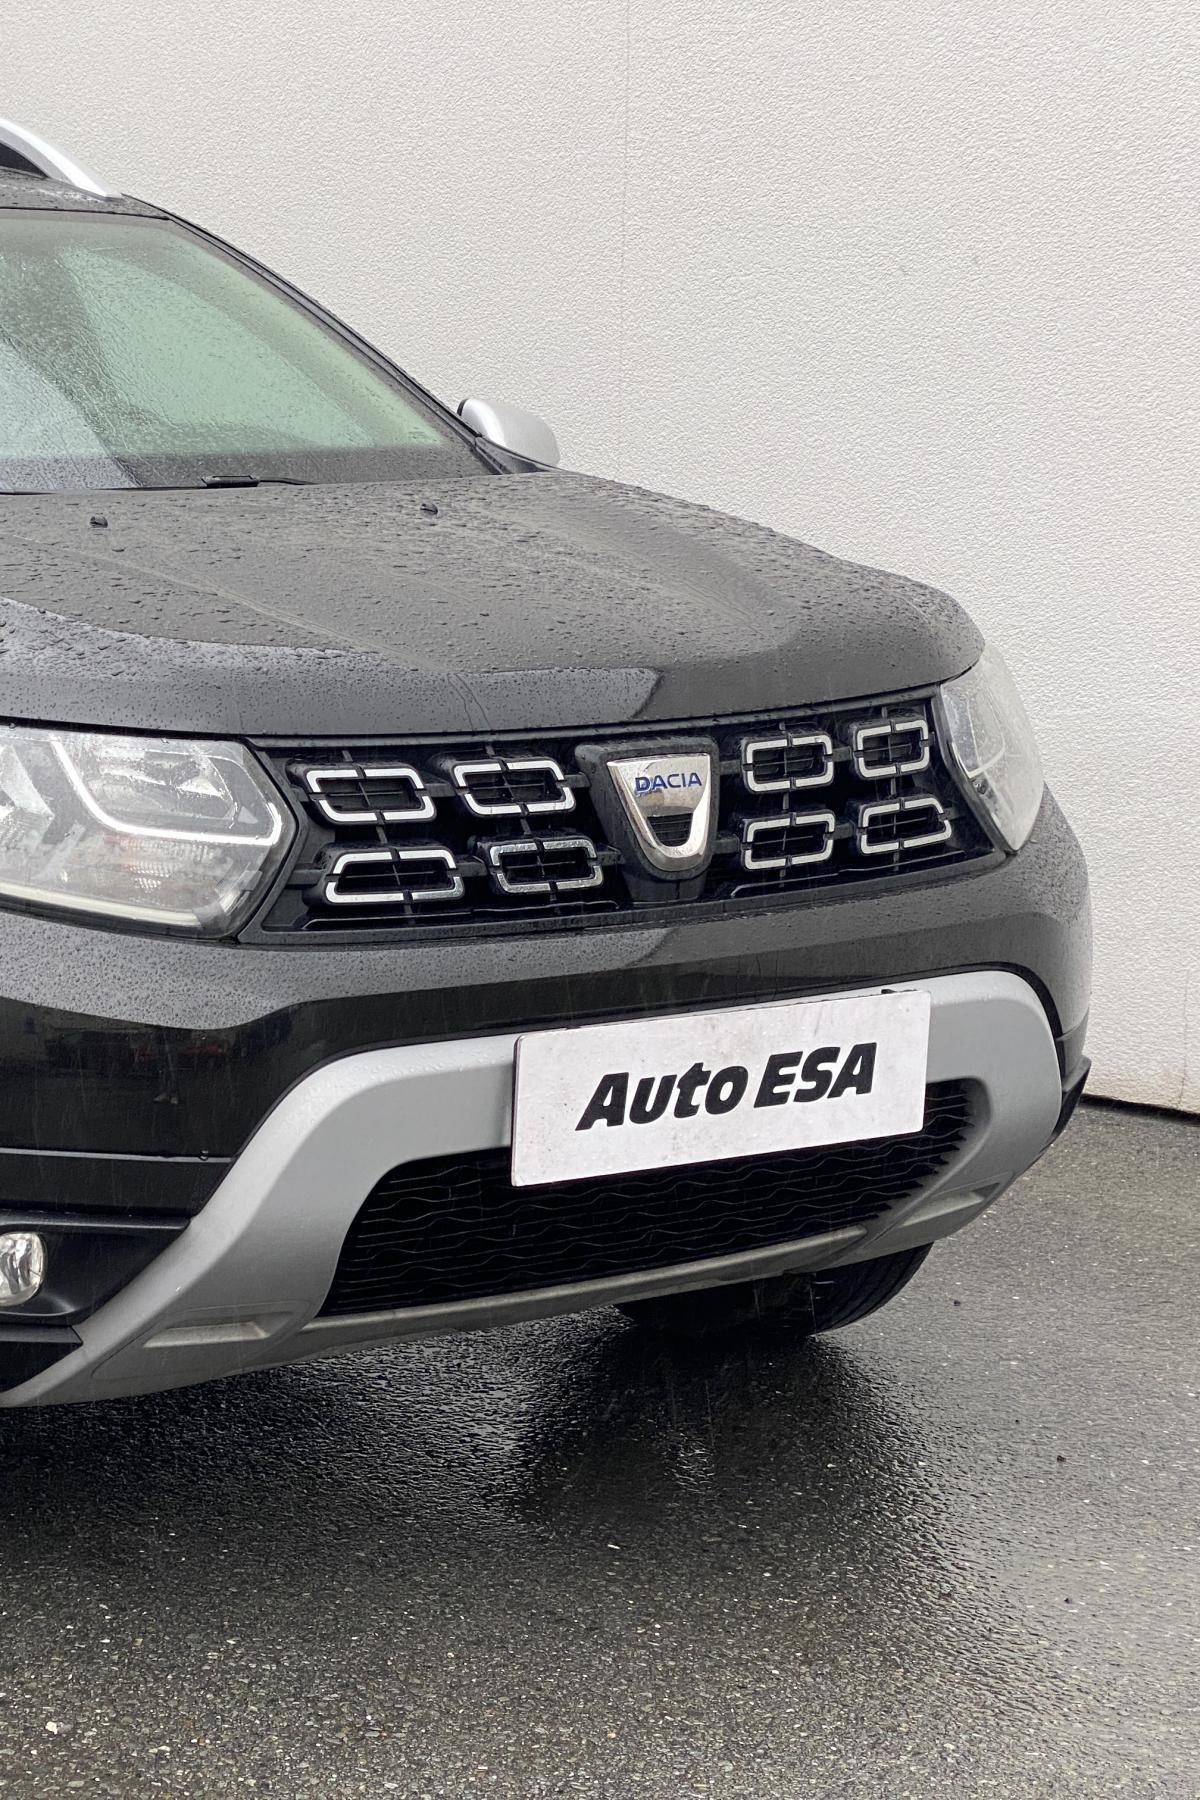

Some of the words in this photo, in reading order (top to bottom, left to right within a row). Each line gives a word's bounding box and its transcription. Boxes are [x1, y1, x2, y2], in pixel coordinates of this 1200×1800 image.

[634, 772, 702, 792] DACIA
[575, 1062, 749, 1131] Auto
[753, 1042, 877, 1108] ESA
